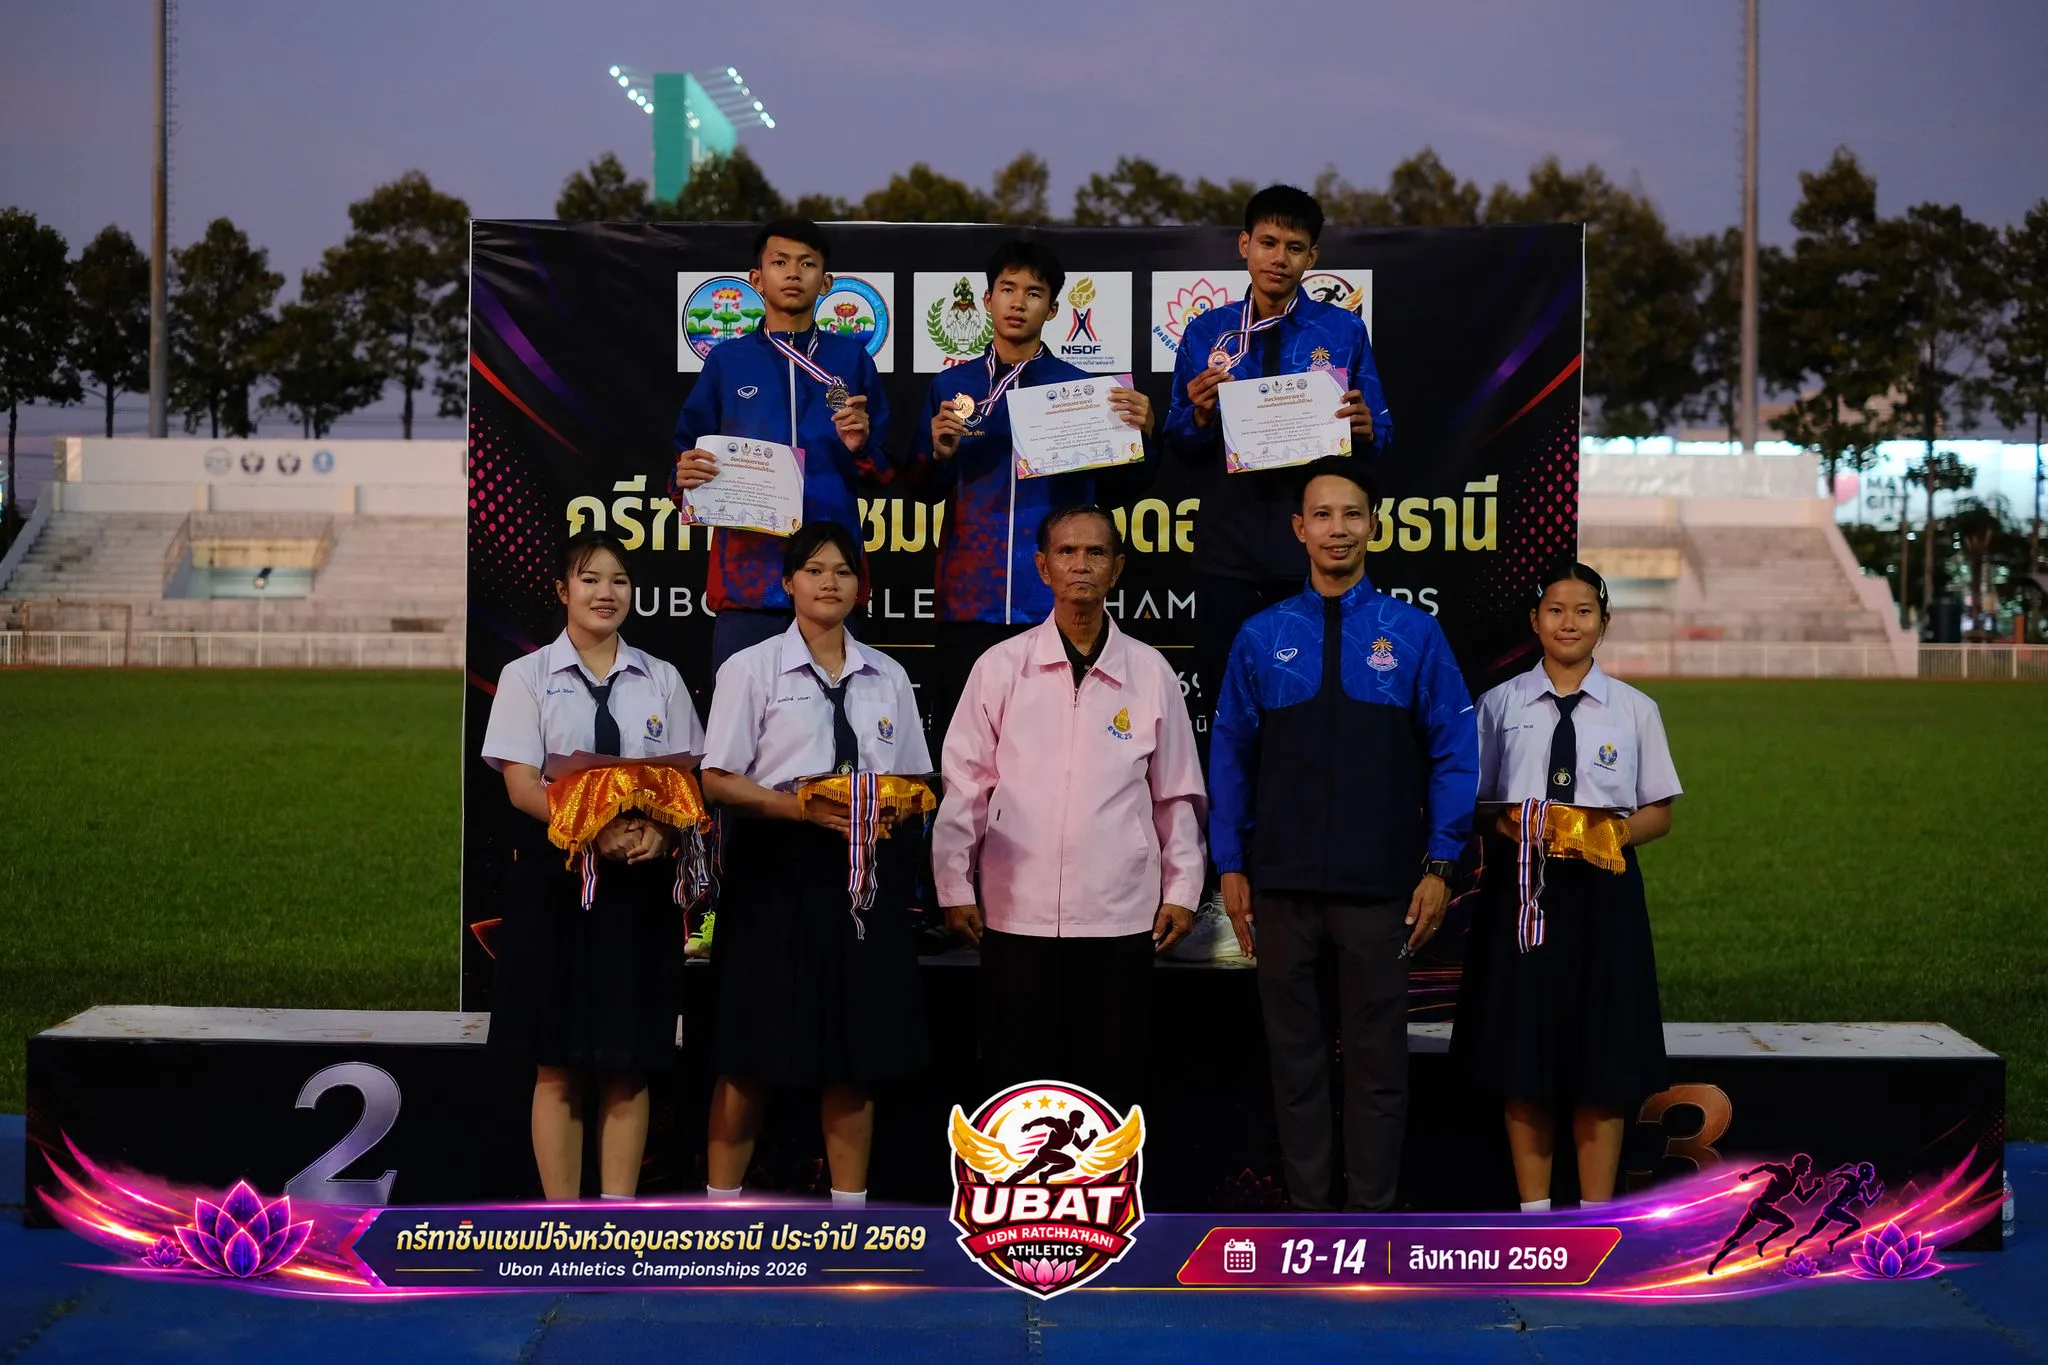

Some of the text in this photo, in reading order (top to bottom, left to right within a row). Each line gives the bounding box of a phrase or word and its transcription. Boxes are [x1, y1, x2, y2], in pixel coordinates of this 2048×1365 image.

[1061, 345, 1102, 355] NSDF
[283, 1061, 402, 1206] 2
[1628, 1083, 1733, 1185] 3
